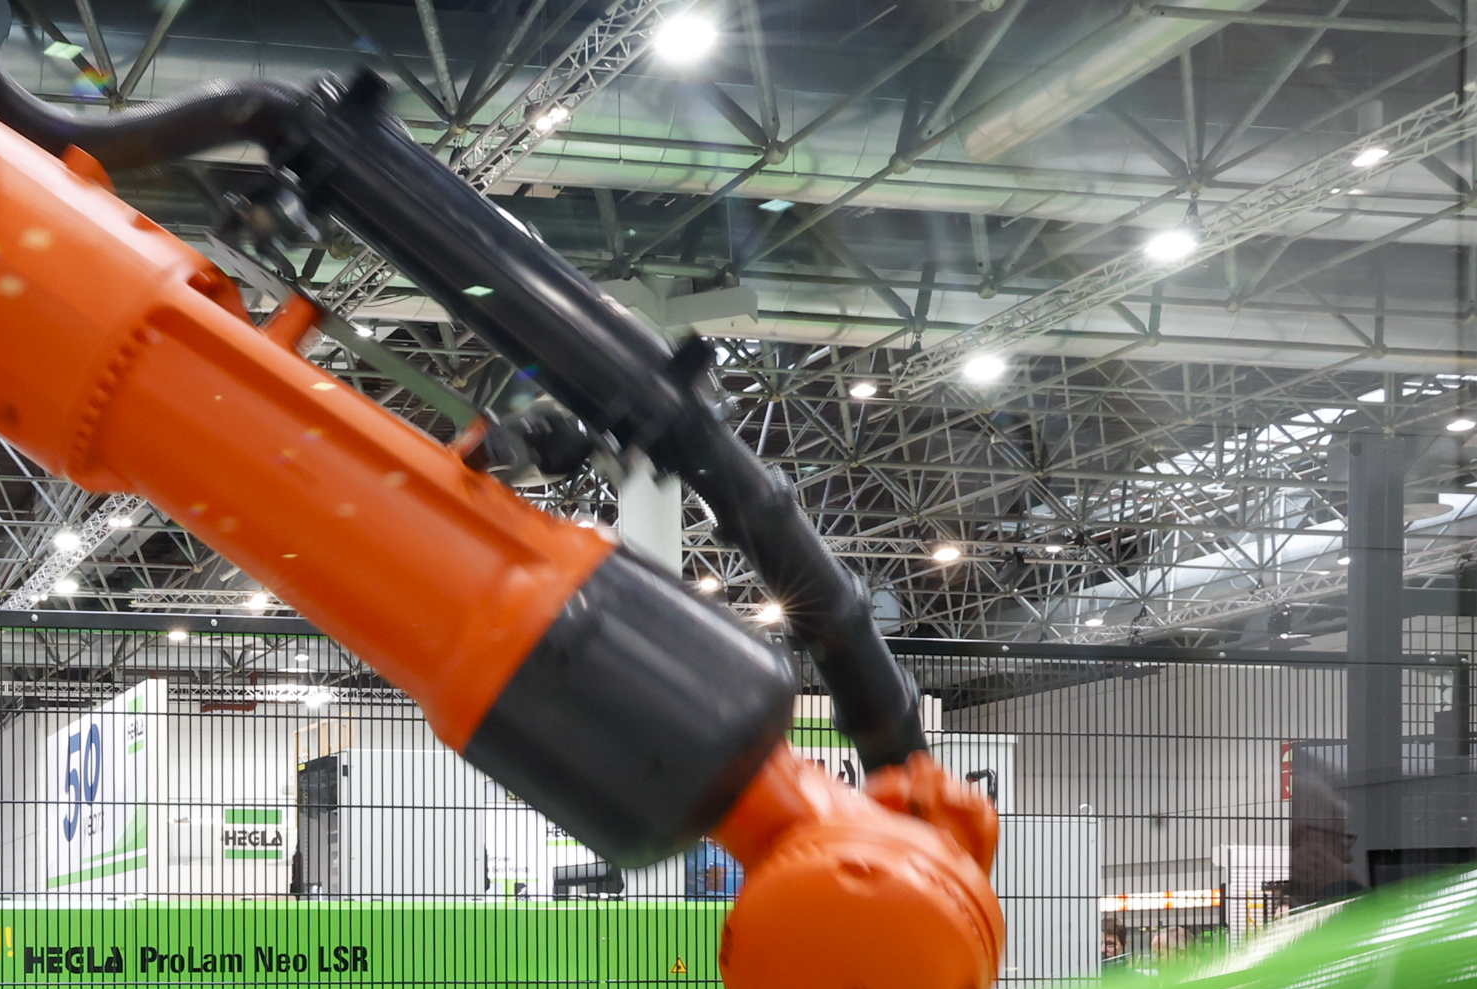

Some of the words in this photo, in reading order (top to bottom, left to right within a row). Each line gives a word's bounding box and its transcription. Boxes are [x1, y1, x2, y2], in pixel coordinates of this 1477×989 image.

[127, 717, 144, 742] HELA
[63, 723, 101, 842] 50
[224, 830, 283, 847] HEGLA
[487, 854, 512, 863] Servie
[25, 946, 124, 974] HEGLA
[140, 946, 243, 974] ProLam
[255, 946, 308, 973] Neo
[319, 946, 368, 973] LSR
